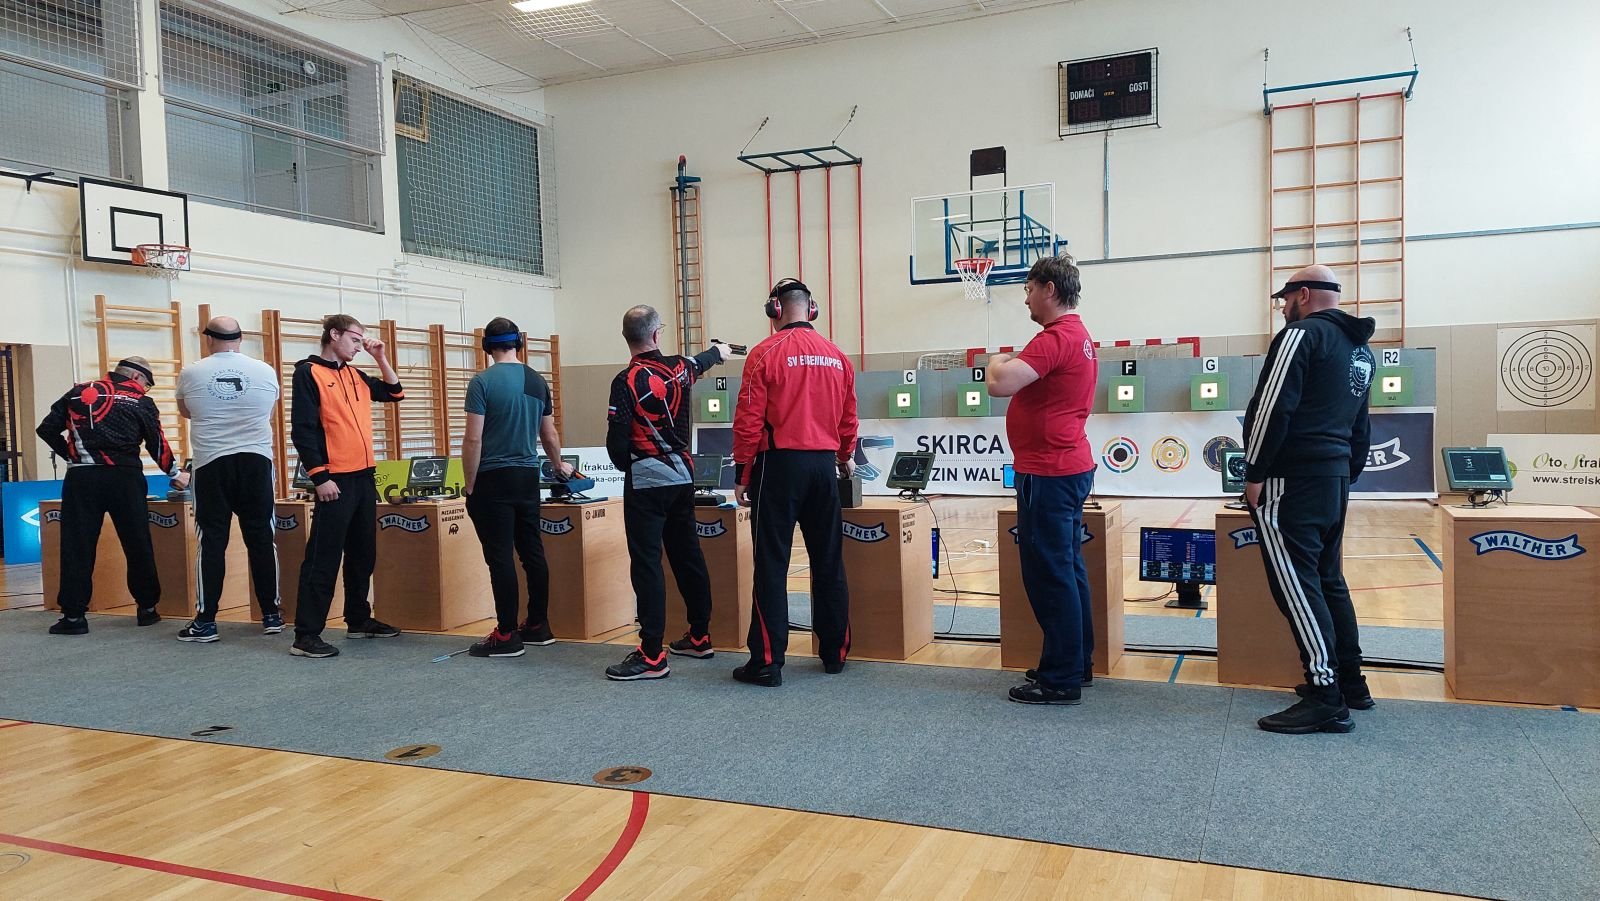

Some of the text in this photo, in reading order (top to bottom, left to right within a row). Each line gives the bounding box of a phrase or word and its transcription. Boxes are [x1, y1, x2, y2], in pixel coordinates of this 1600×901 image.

[1128, 81, 1149, 93] GOSTI
[787, 355, 798, 368] SV
[1384, 351, 1399, 364] R2
[1125, 361, 1134, 374] F
[1205, 359, 1216, 371] G
[905, 371, 914, 383] C
[974, 369, 984, 381] D
[716, 378, 727, 390] R1
[916, 434, 1005, 455] SKIRCA
[1532, 452, 1563, 469] Oto
[927, 467, 959, 482] ZIN
[384, 516, 424, 531] WALTHER
[1485, 535, 1567, 556] WALTHER
